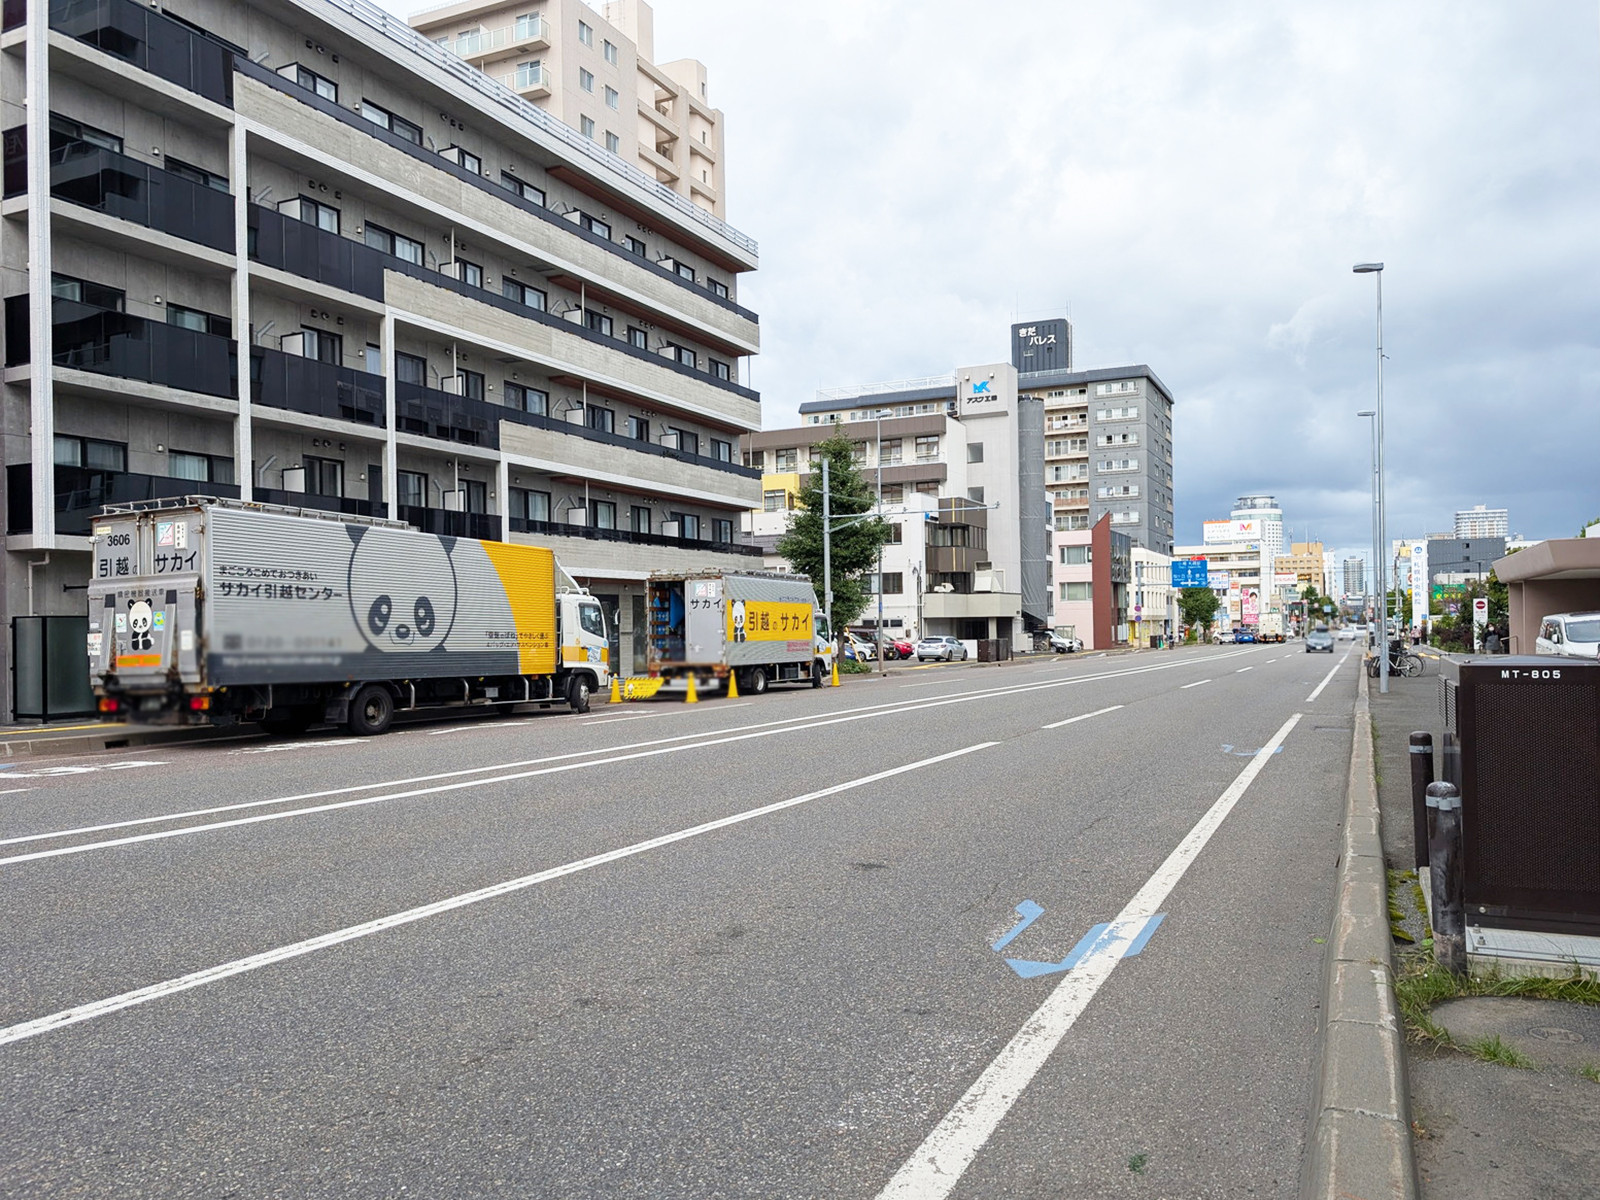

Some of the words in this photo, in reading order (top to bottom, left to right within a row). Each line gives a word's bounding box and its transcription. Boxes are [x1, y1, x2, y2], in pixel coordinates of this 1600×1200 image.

[1019, 326, 1036, 337] きだ
[1029, 334, 1056, 346] パレス
[107, 534, 131, 547] 3606
[155, 550, 197, 573] サカイ
[219, 565, 318, 580] まごころこめておつきあい
[220, 582, 342, 600] サカイ引越センター
[690, 598, 722, 610] サカイ
[748, 611, 810, 632] 引越のサカイ
[1501, 670, 1561, 679] MT-805
